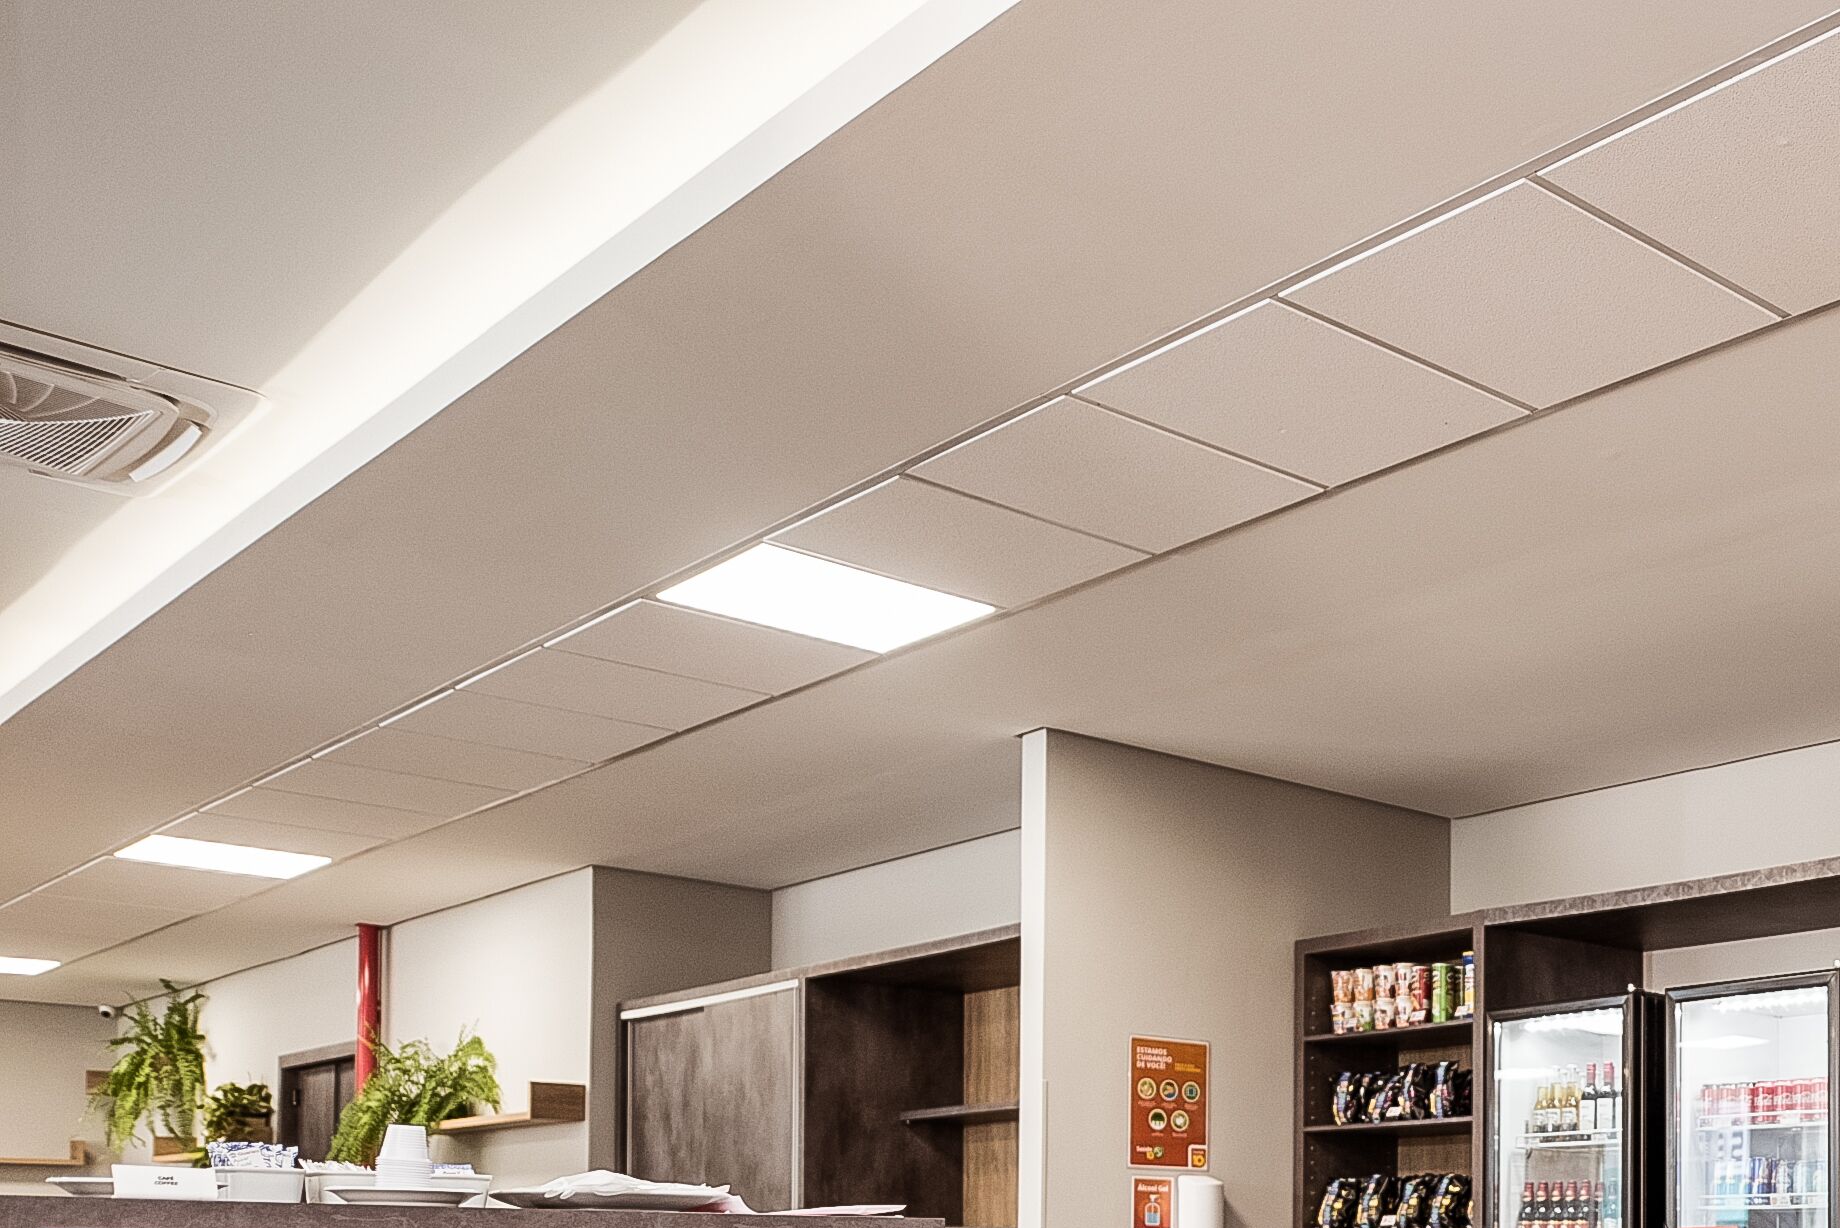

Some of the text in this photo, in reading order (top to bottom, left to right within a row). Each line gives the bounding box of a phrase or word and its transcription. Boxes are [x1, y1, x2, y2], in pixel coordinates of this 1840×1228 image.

[1136, 1046, 1167, 1056] ESTAMOS
[1136, 1053, 1173, 1064] CUIDANDO
[1136, 1061, 1144, 1069] DE
[1137, 1182, 1169, 1193] Álcool Gel
